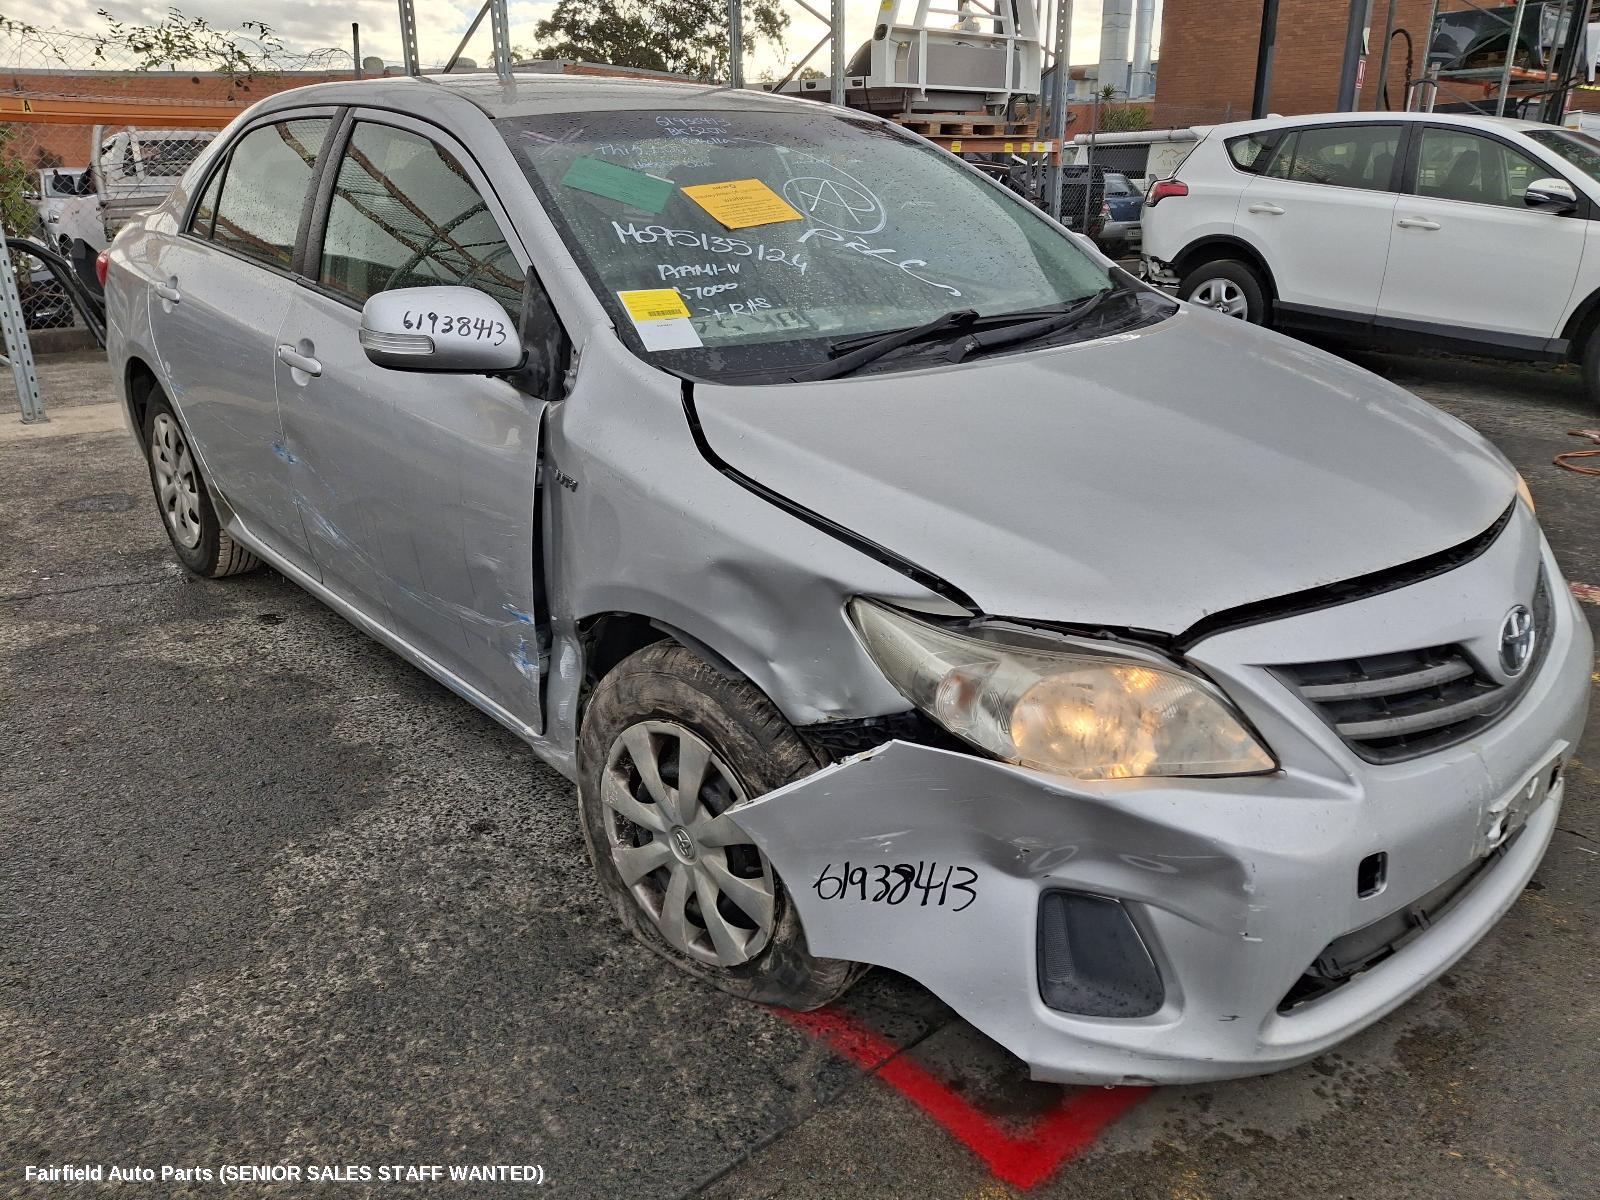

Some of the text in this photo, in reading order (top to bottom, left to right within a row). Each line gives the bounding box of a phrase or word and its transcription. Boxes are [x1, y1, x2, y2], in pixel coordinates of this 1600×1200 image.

[23, 100, 32, 112] A
[402, 310, 507, 347] 61938413
[812, 860, 979, 912] 61938413
